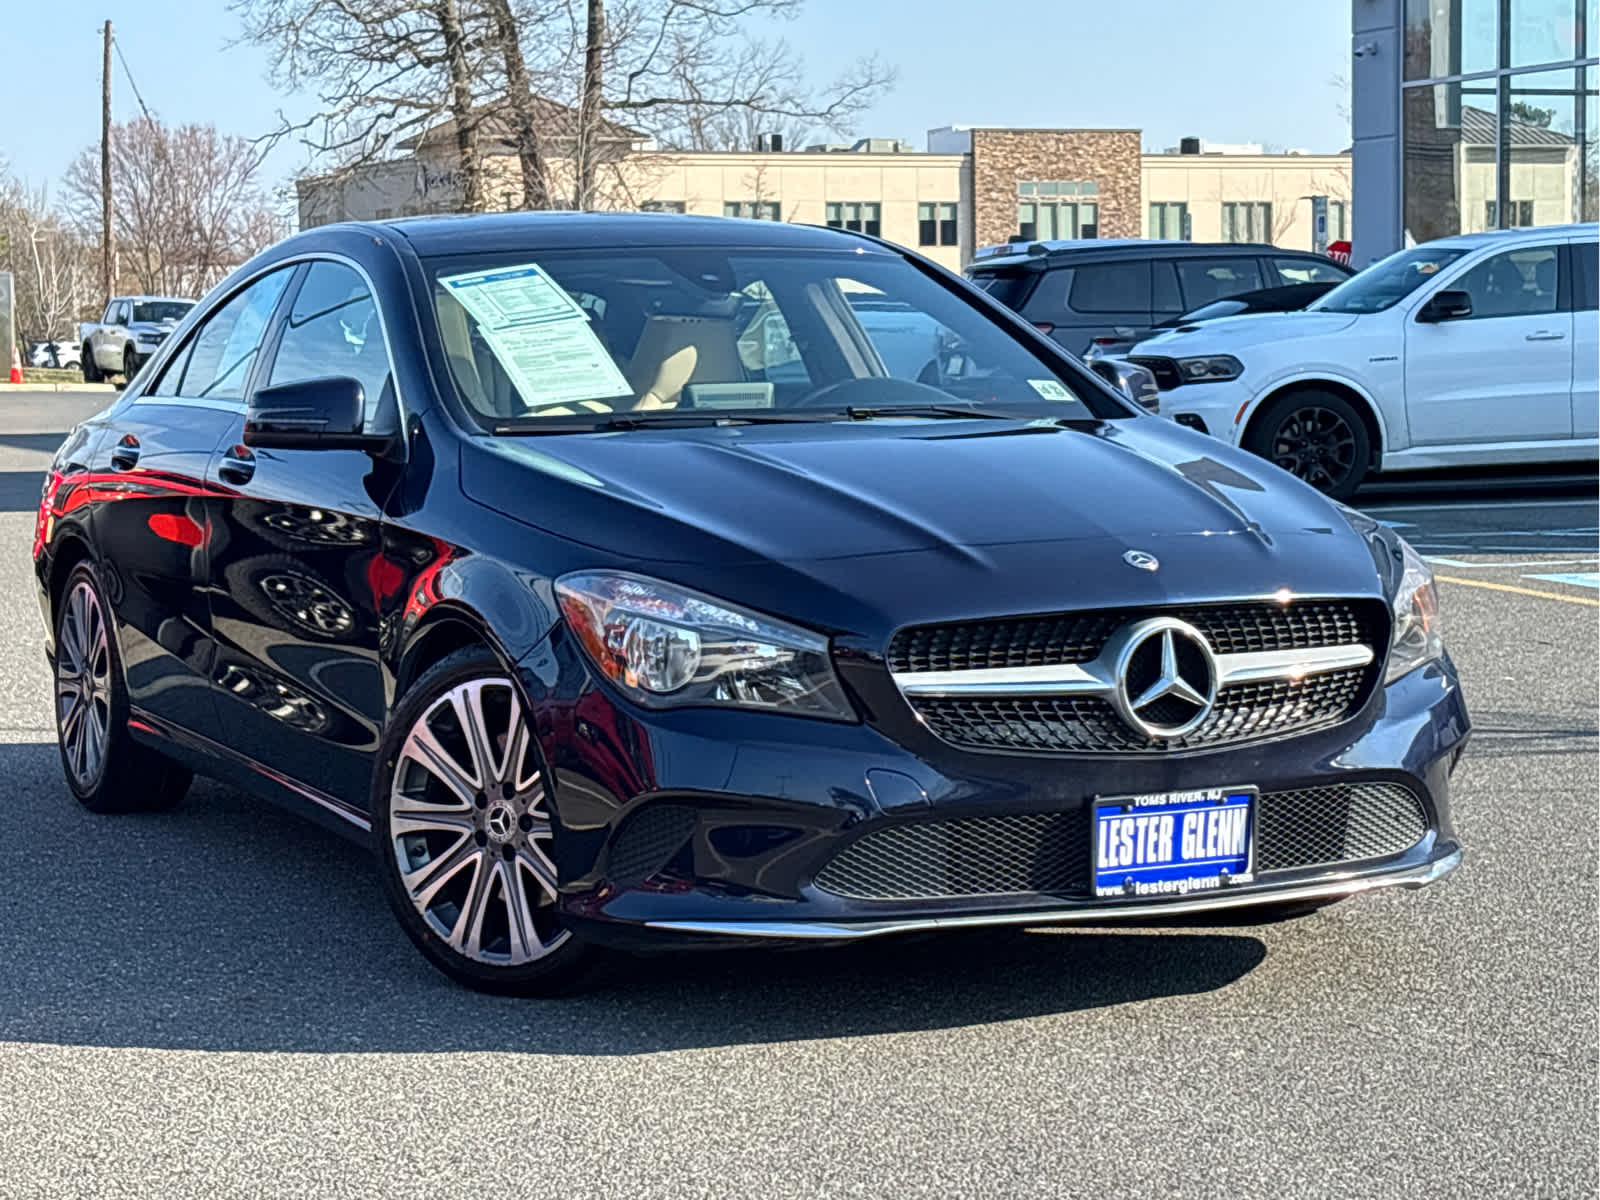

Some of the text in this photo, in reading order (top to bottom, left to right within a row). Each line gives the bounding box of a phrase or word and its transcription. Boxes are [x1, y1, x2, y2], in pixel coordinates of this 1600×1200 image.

[1134, 794, 1167, 807] TOMS
[1207, 789, 1222, 801] NJ
[1098, 808, 1247, 868] LESTER GLENN
